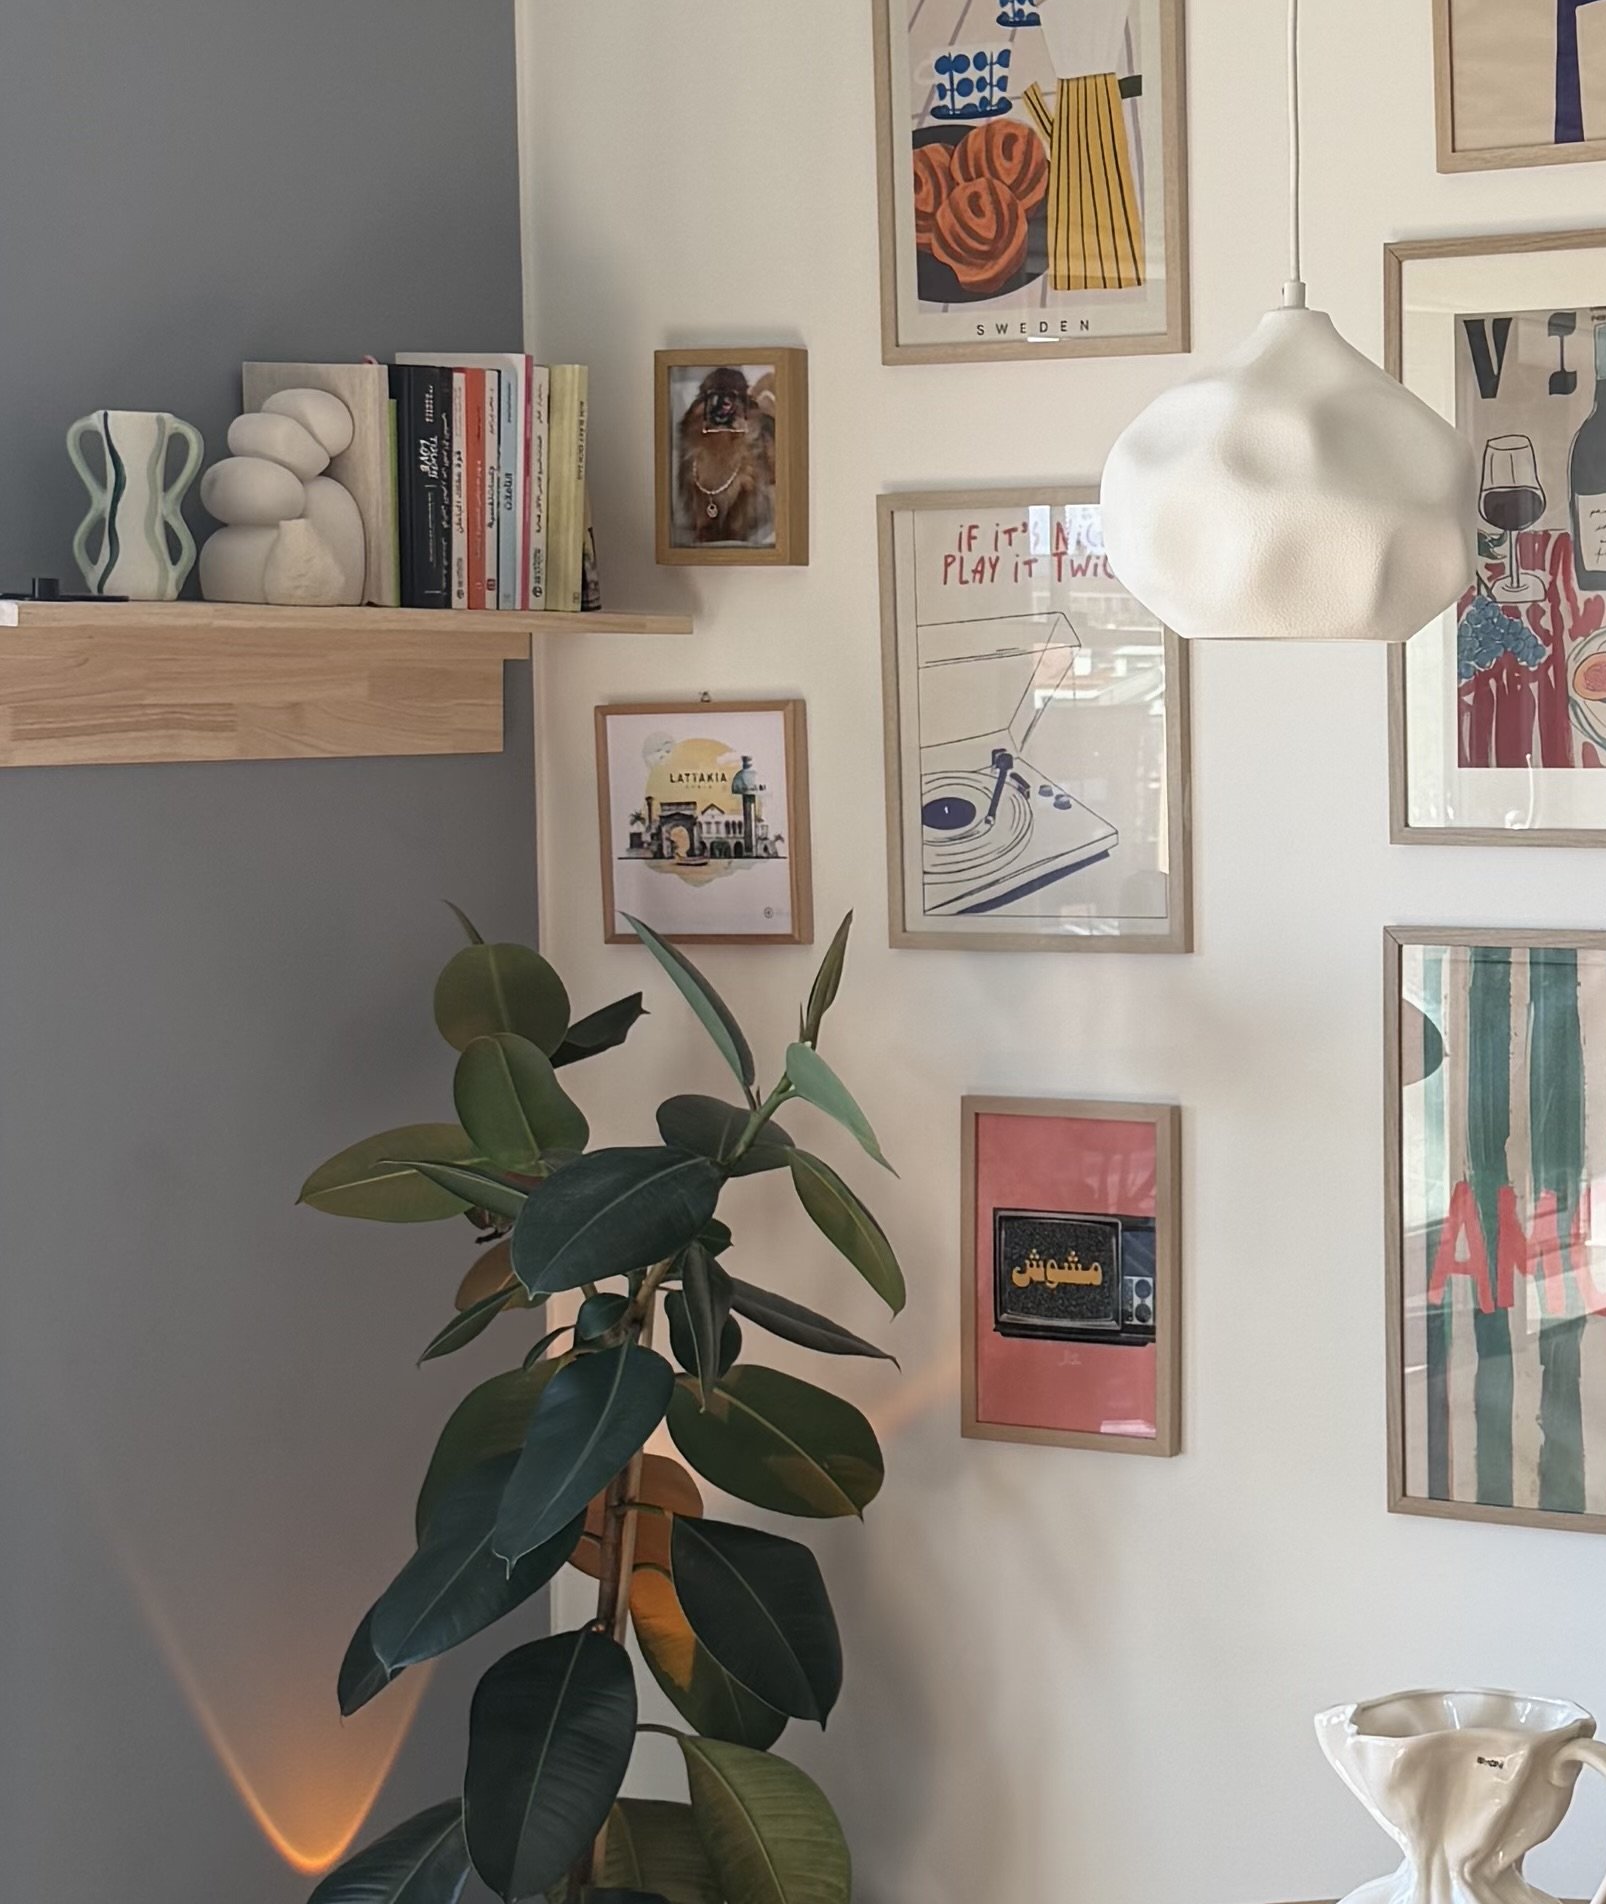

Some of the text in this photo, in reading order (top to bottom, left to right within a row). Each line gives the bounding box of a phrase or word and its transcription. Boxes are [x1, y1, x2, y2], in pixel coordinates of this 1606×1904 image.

[976, 318, 1091, 336] SWEDEN
[418, 439, 430, 473] LOVE
[943, 553, 1000, 586] PLAY
[669, 772, 728, 784] LATTAKIA
[1011, 1247, 1104, 1295] مشوش
